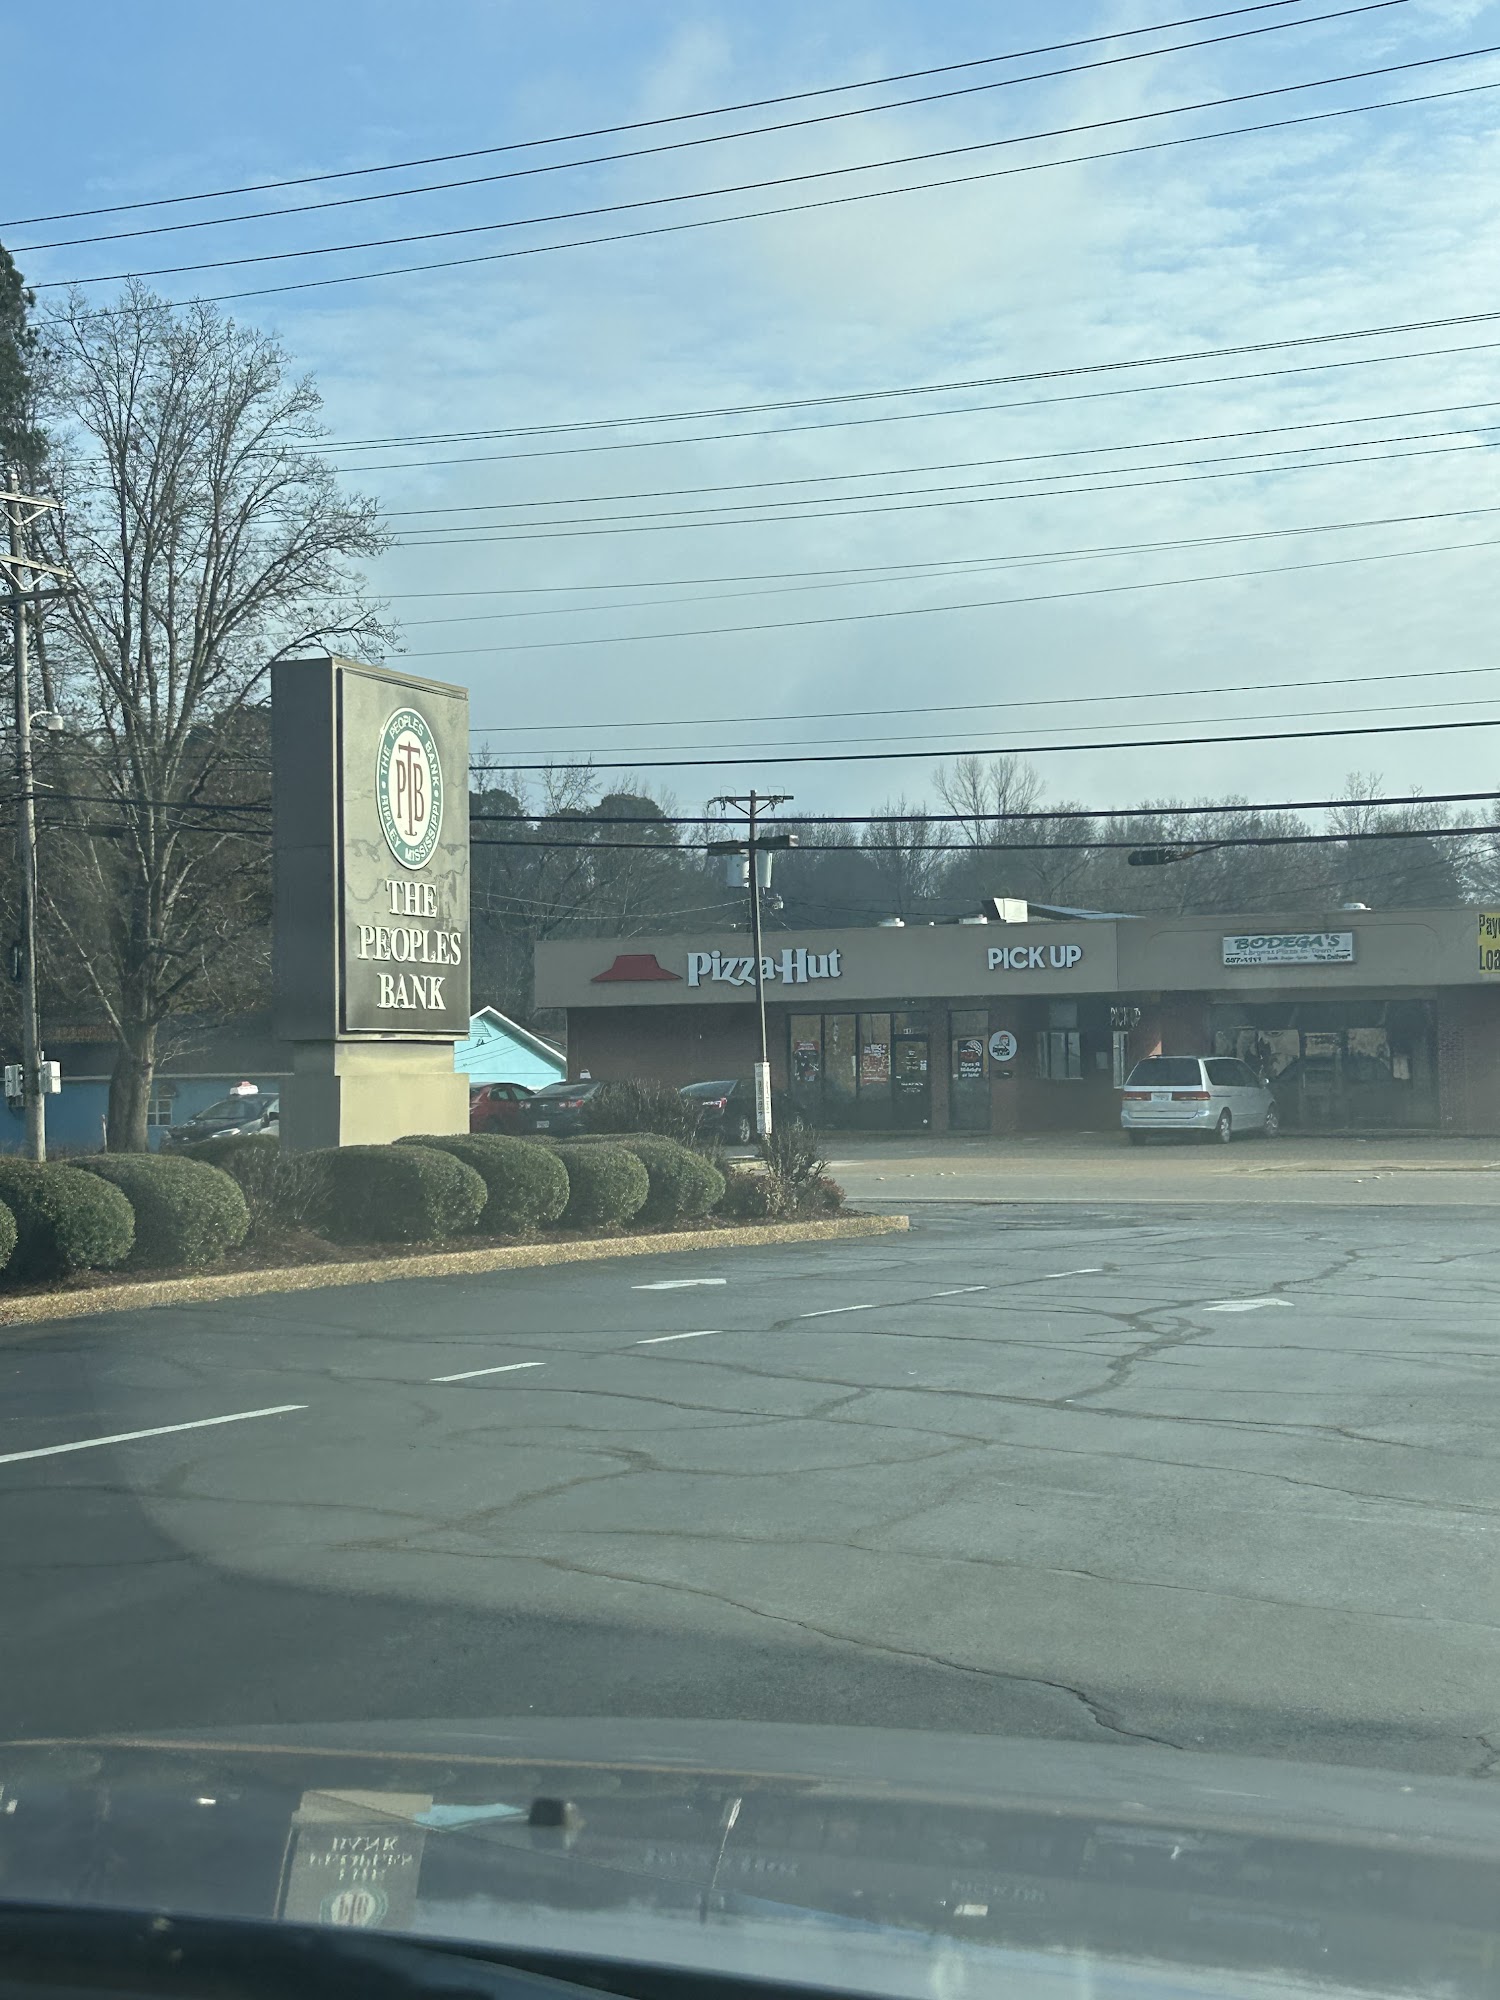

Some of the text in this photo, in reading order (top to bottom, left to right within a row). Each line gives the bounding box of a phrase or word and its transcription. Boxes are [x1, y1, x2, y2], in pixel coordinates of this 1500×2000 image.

[380, 715, 440, 786] THE PEOPLES BANK
[381, 794, 440, 862] RIPLEY MISSISSIPPI
[385, 878, 438, 918] THE
[357, 925, 462, 966] PEOPLES
[987, 944, 1082, 970] PICK UP
[1235, 935, 1340, 949] BODEGA'S
[687, 948, 842, 987] Pizza Hut
[377, 972, 447, 1010] BANK
